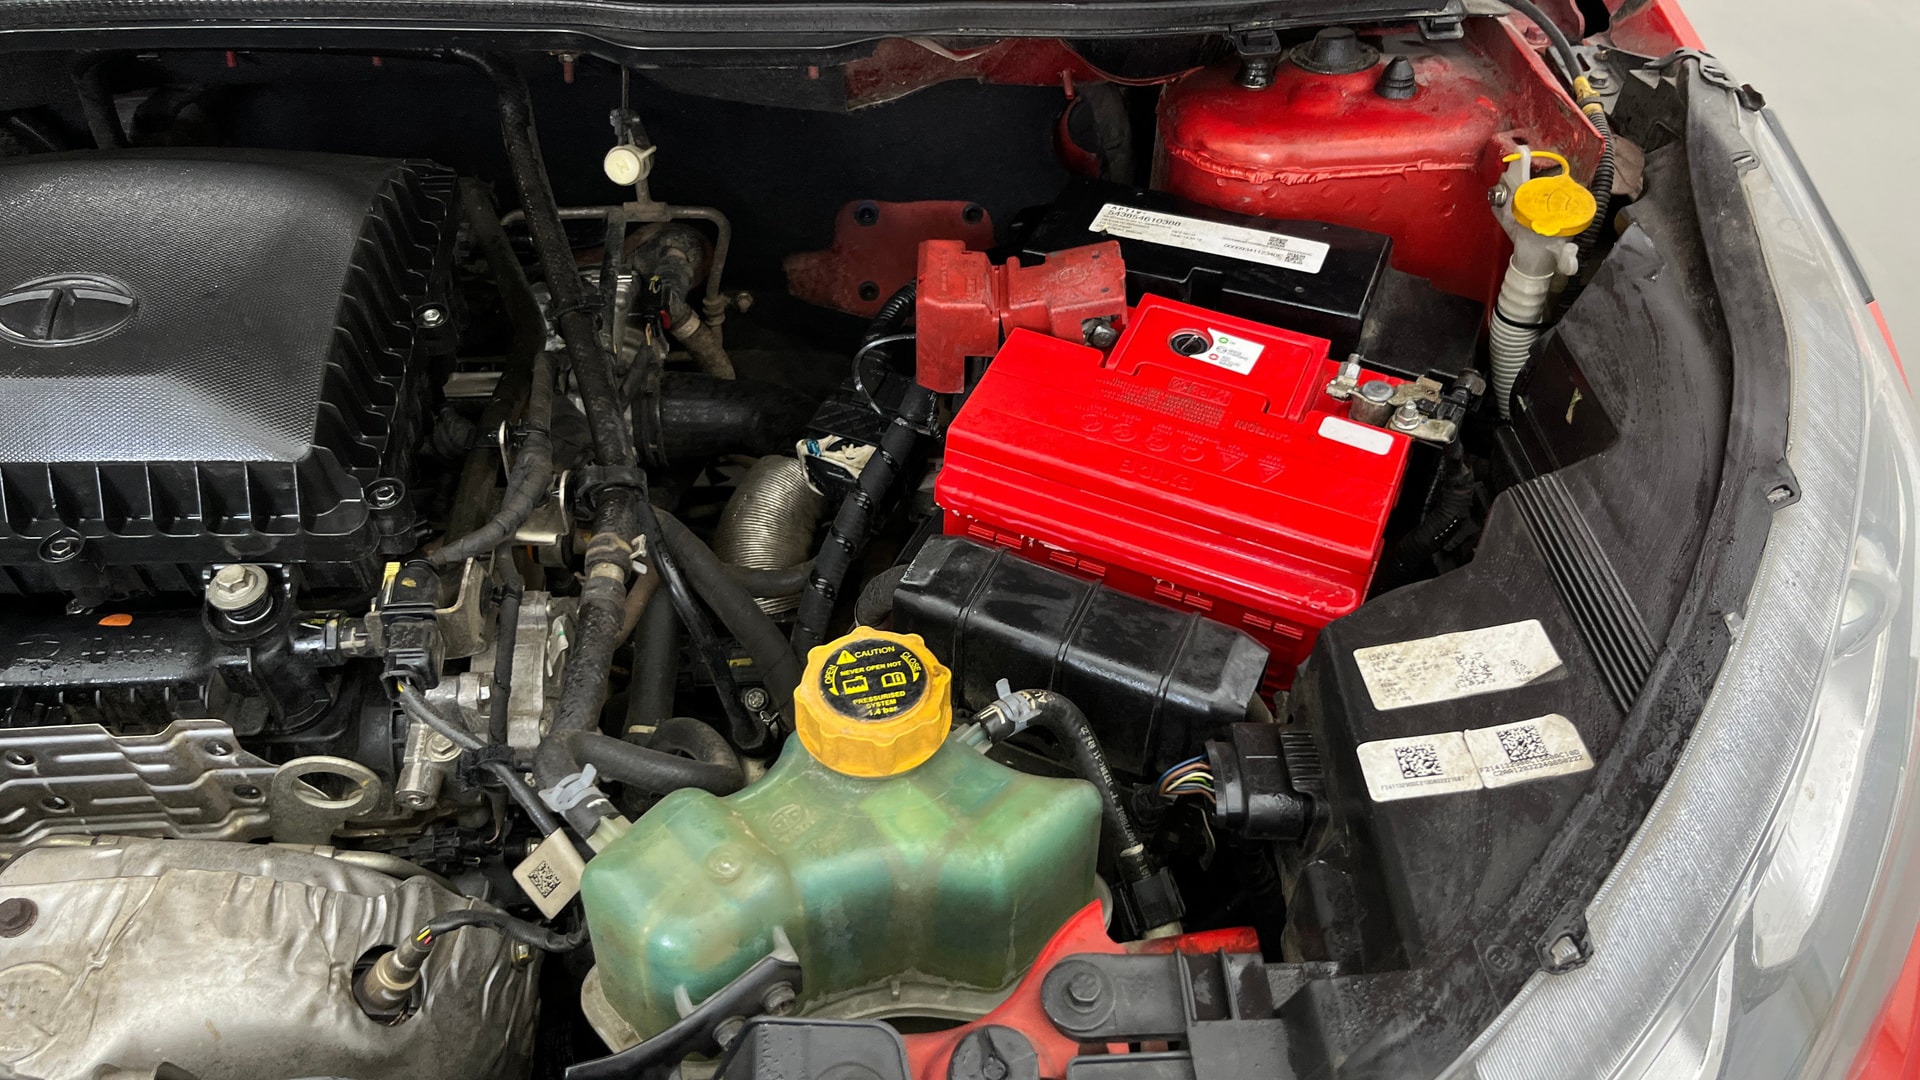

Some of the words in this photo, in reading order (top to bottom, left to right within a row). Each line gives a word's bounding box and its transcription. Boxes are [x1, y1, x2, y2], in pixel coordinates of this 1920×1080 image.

[854, 646, 895, 658] CAUTION
[840, 667, 865, 677] NEVER
[886, 660, 902, 669] HOT
[902, 651, 921, 671] CLOSE
[824, 664, 836, 684] OPEN
[852, 690, 906, 705] PRESSURISED
[866, 698, 897, 710] SYSTEM
[868, 707, 882, 717] 1.4
